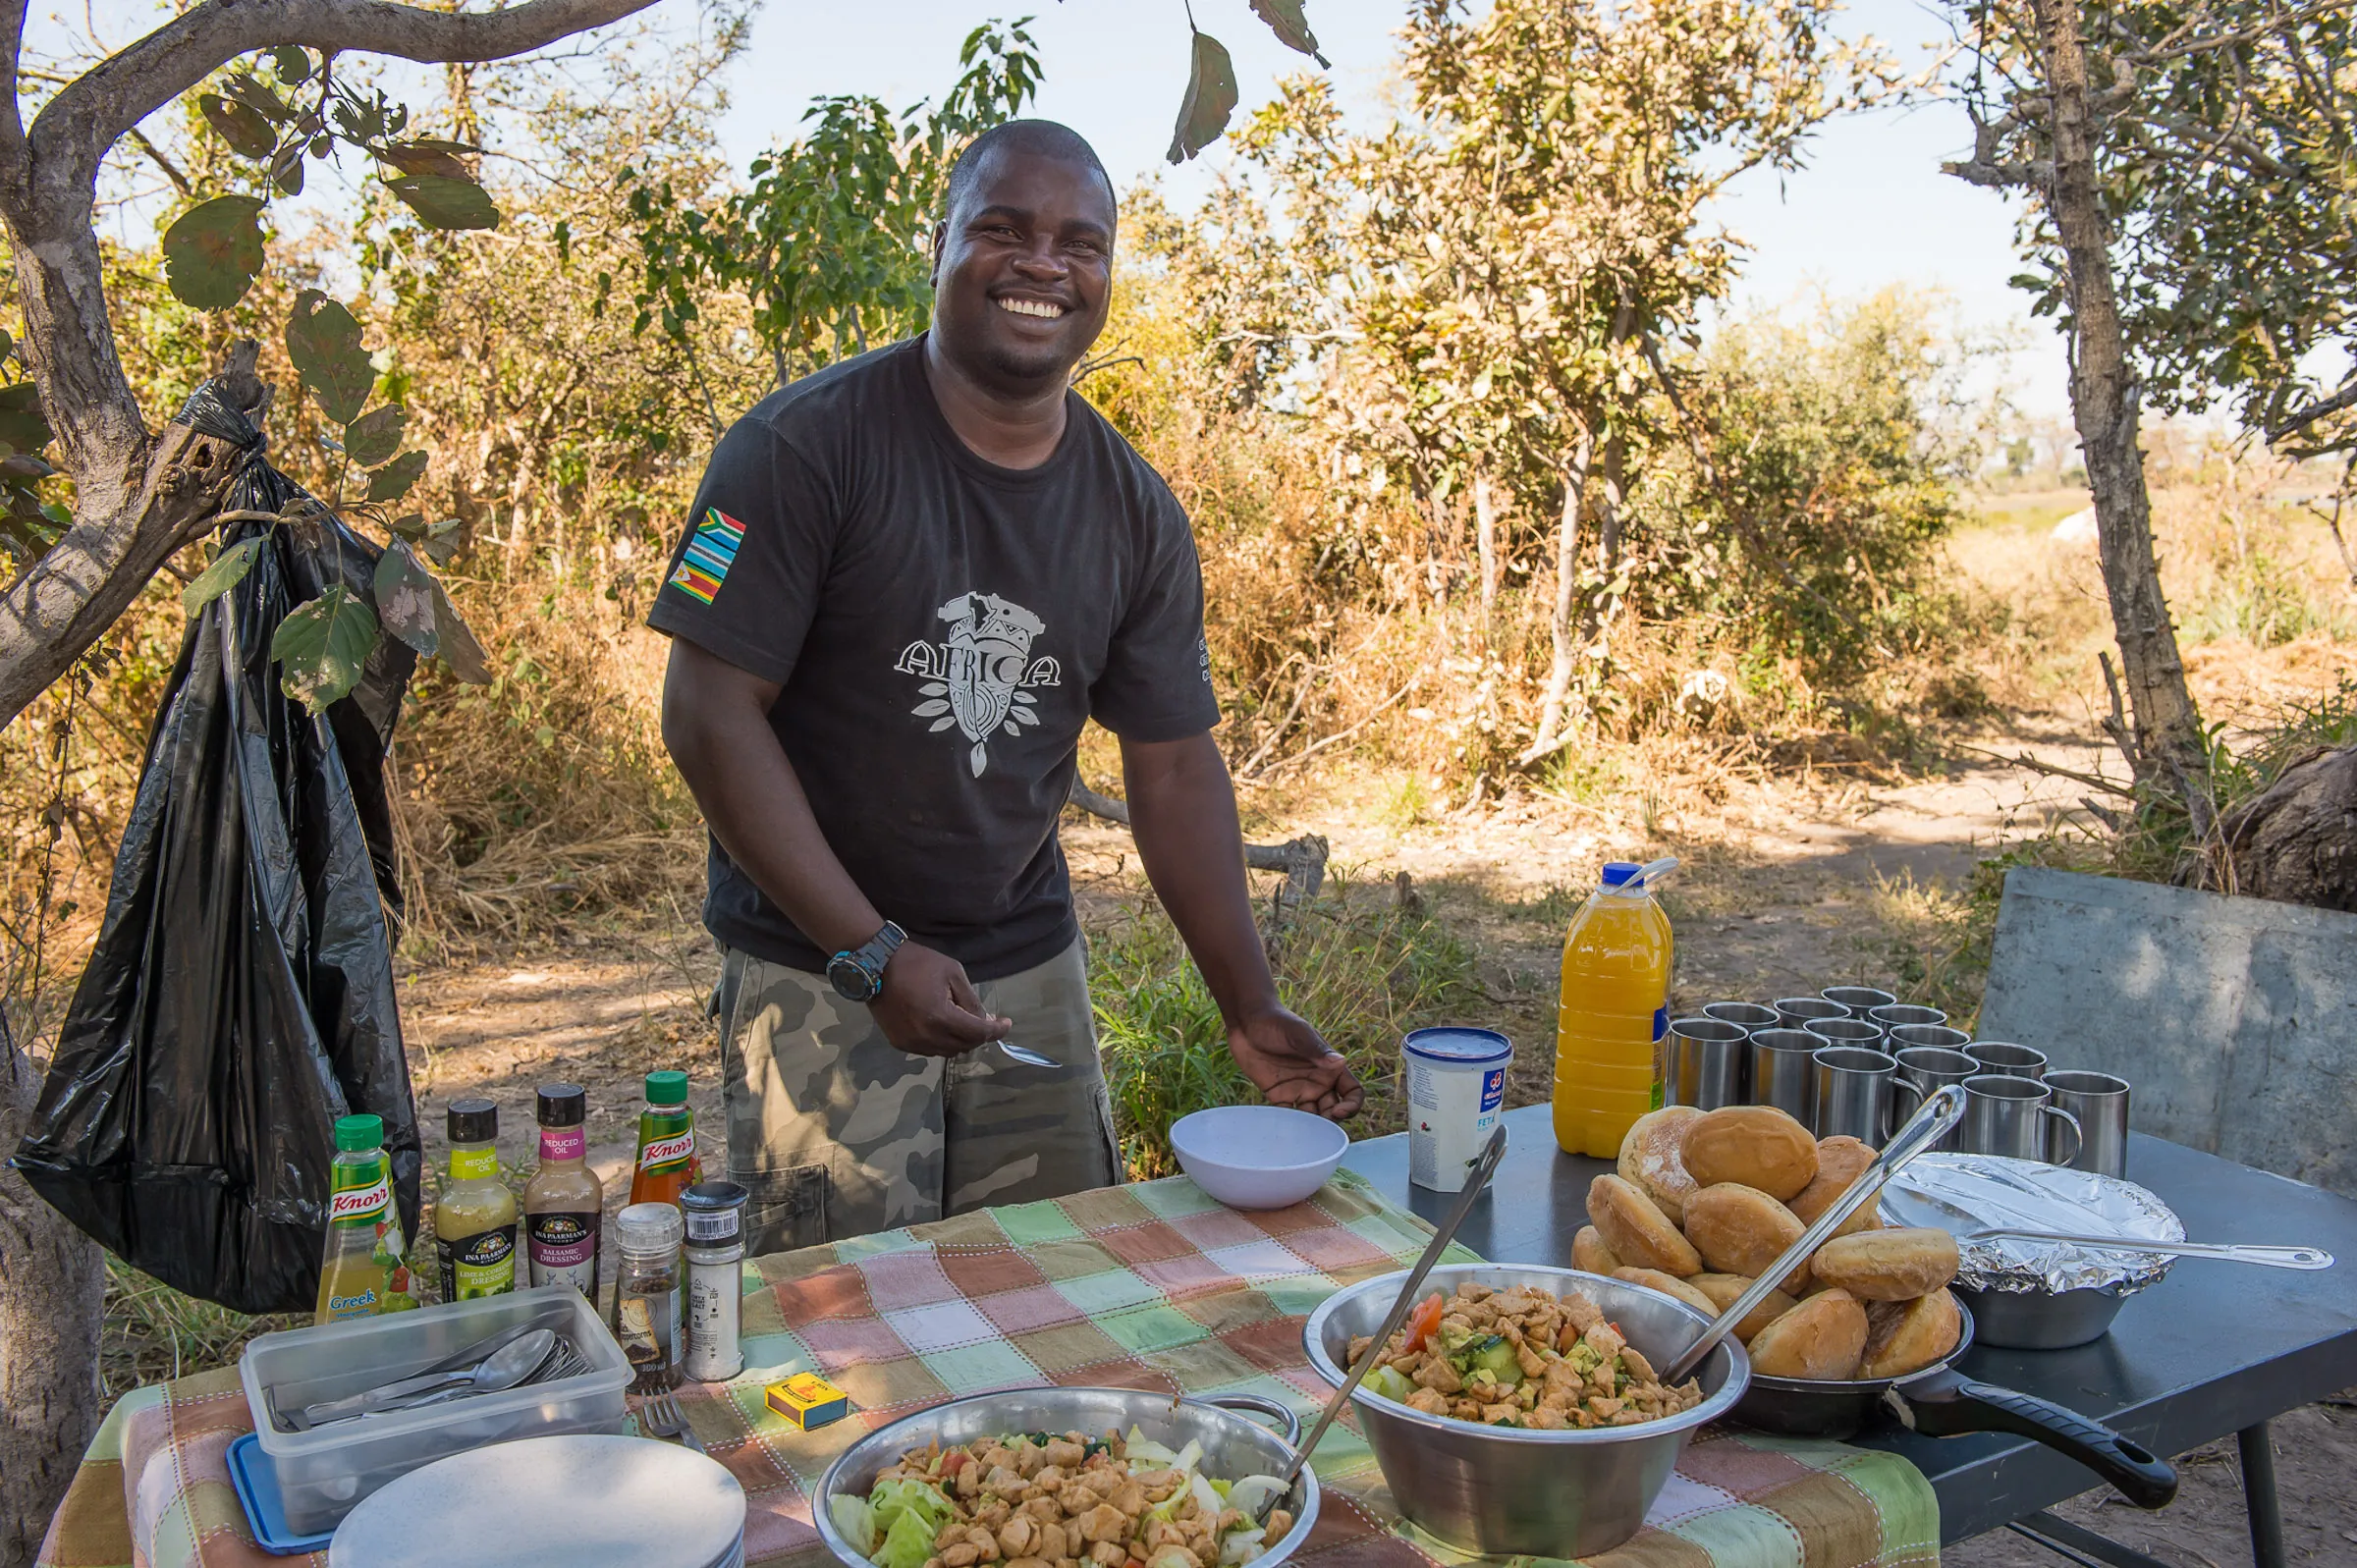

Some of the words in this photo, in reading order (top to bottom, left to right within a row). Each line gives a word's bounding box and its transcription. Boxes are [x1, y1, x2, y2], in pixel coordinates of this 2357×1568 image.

[894, 640, 1061, 687] AFRICA
[1477, 1115, 1495, 1127] FETA
[545, 1138, 578, 1148] REDUCED
[644, 1138, 692, 1162] Knorr
[466, 1154, 496, 1167] REDUCE
[332, 1187, 388, 1213] Knorr
[540, 1254, 582, 1263] DRESSING
[471, 1269, 510, 1285] DRESSING
[330, 1288, 376, 1311] Greek
[641, 1363, 656, 1373] 100
